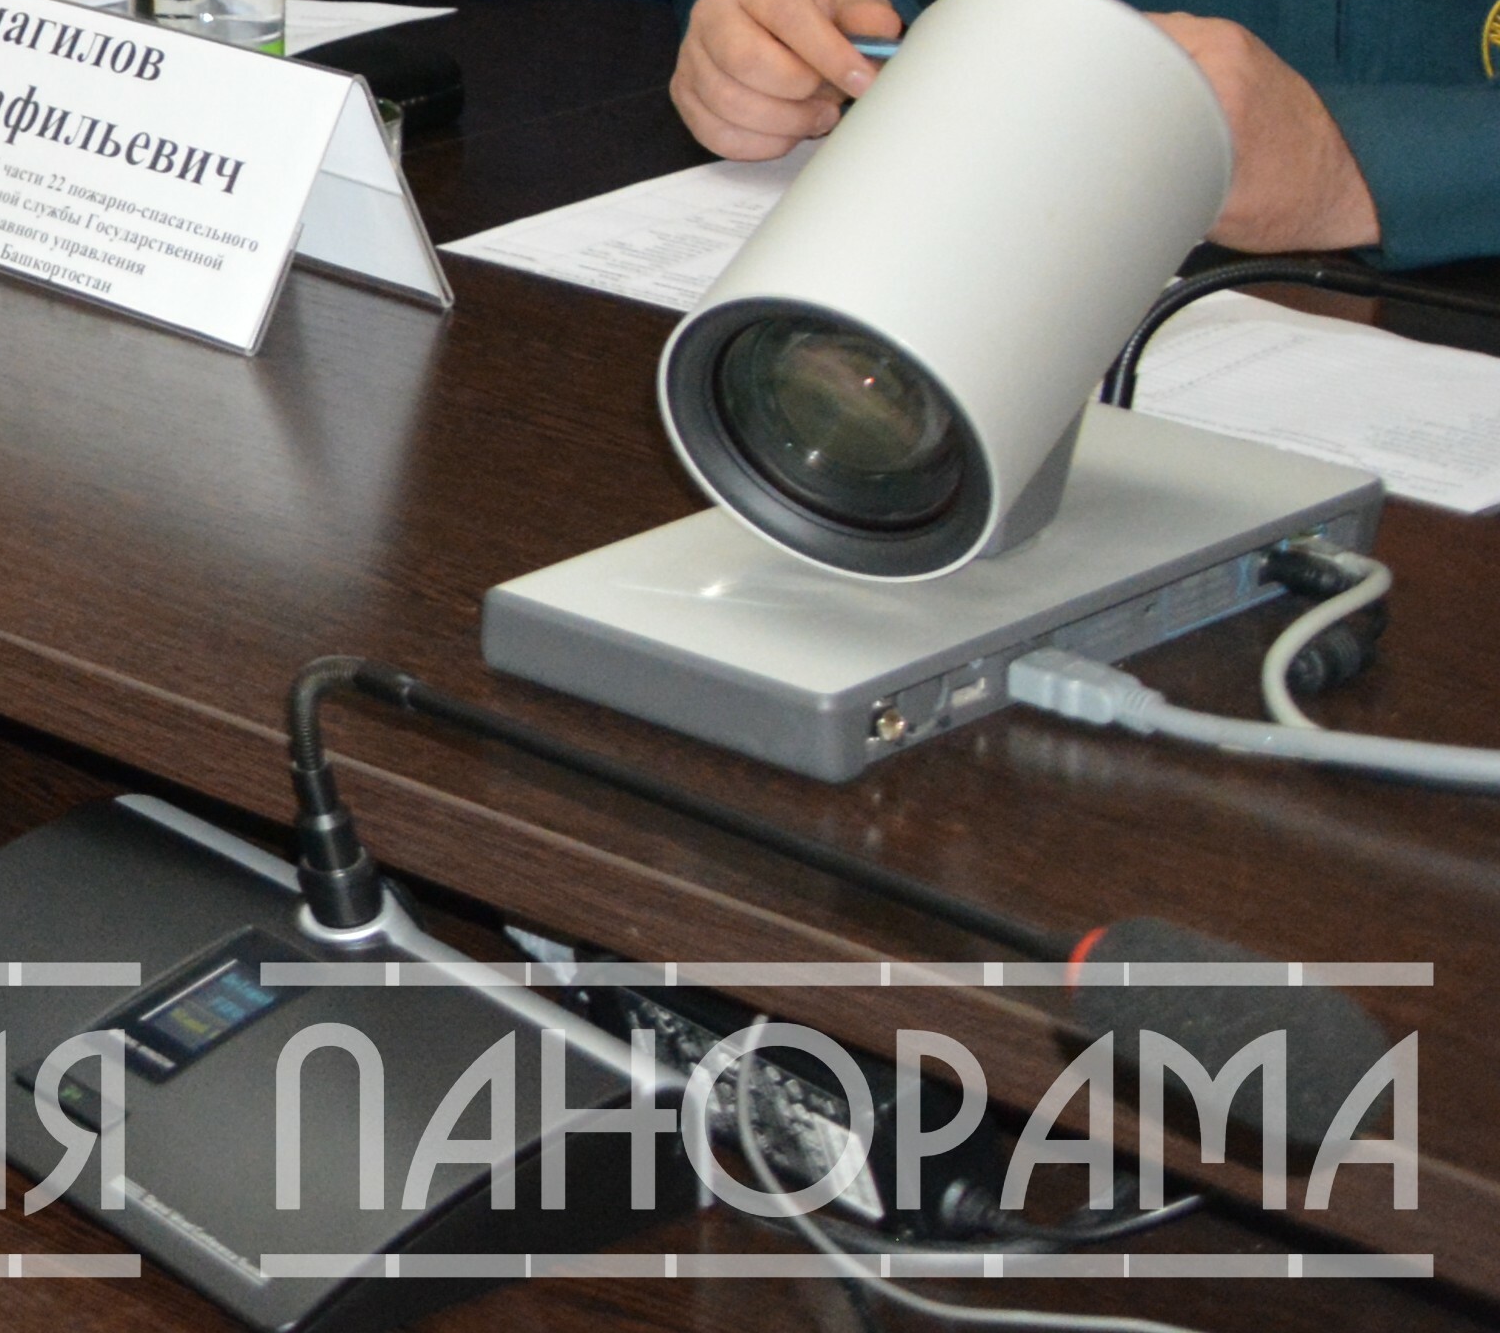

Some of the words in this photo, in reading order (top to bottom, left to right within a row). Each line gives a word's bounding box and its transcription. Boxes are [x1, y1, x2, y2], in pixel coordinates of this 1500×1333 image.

[3, 163, 49, 187] части
[47, 172, 64, 192] 22
[67, 182, 259, 254] пожарно-спасательного
[23, 199, 82, 227] службы
[84, 212, 225, 272] Государственной
[0, 242, 113, 294] Башкортостан
[49, 234, 147, 276] управления
